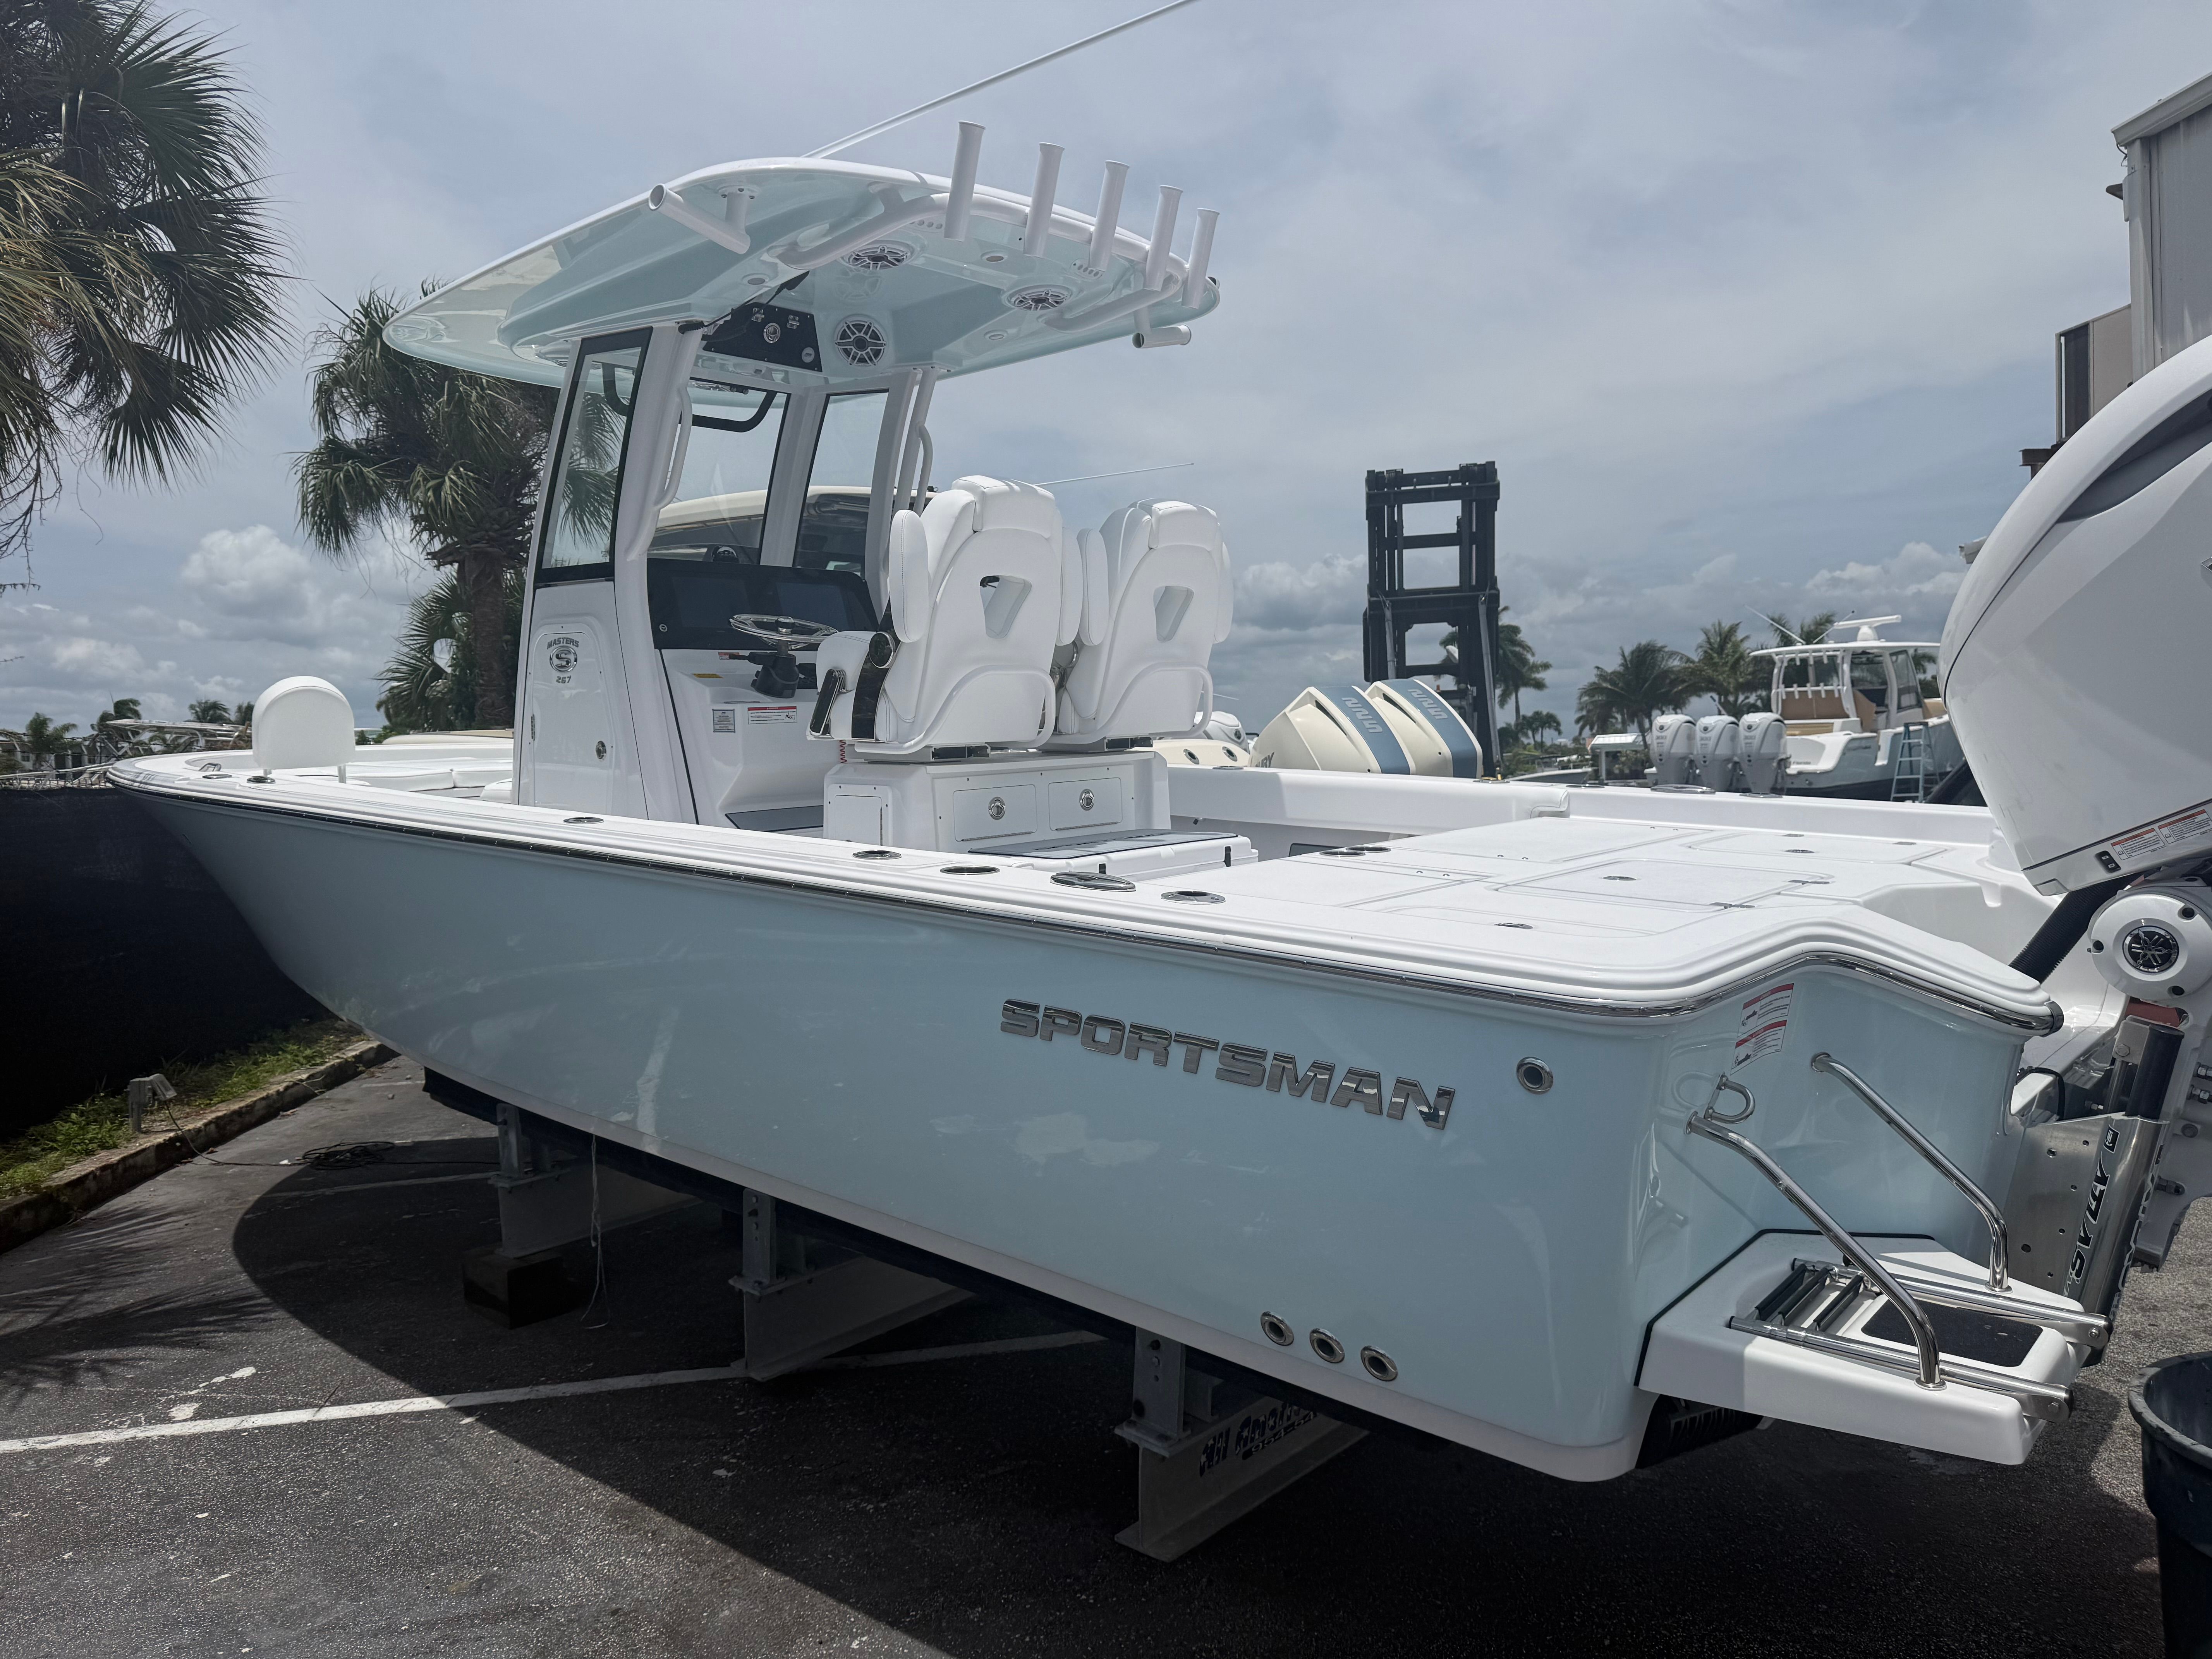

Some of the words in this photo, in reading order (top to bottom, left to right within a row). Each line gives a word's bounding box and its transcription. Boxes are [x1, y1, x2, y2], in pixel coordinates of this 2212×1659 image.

[547, 637, 579, 649] MASTERS
[556, 675, 571, 684] 267
[1000, 998, 1455, 1130] SPORTSMAN
